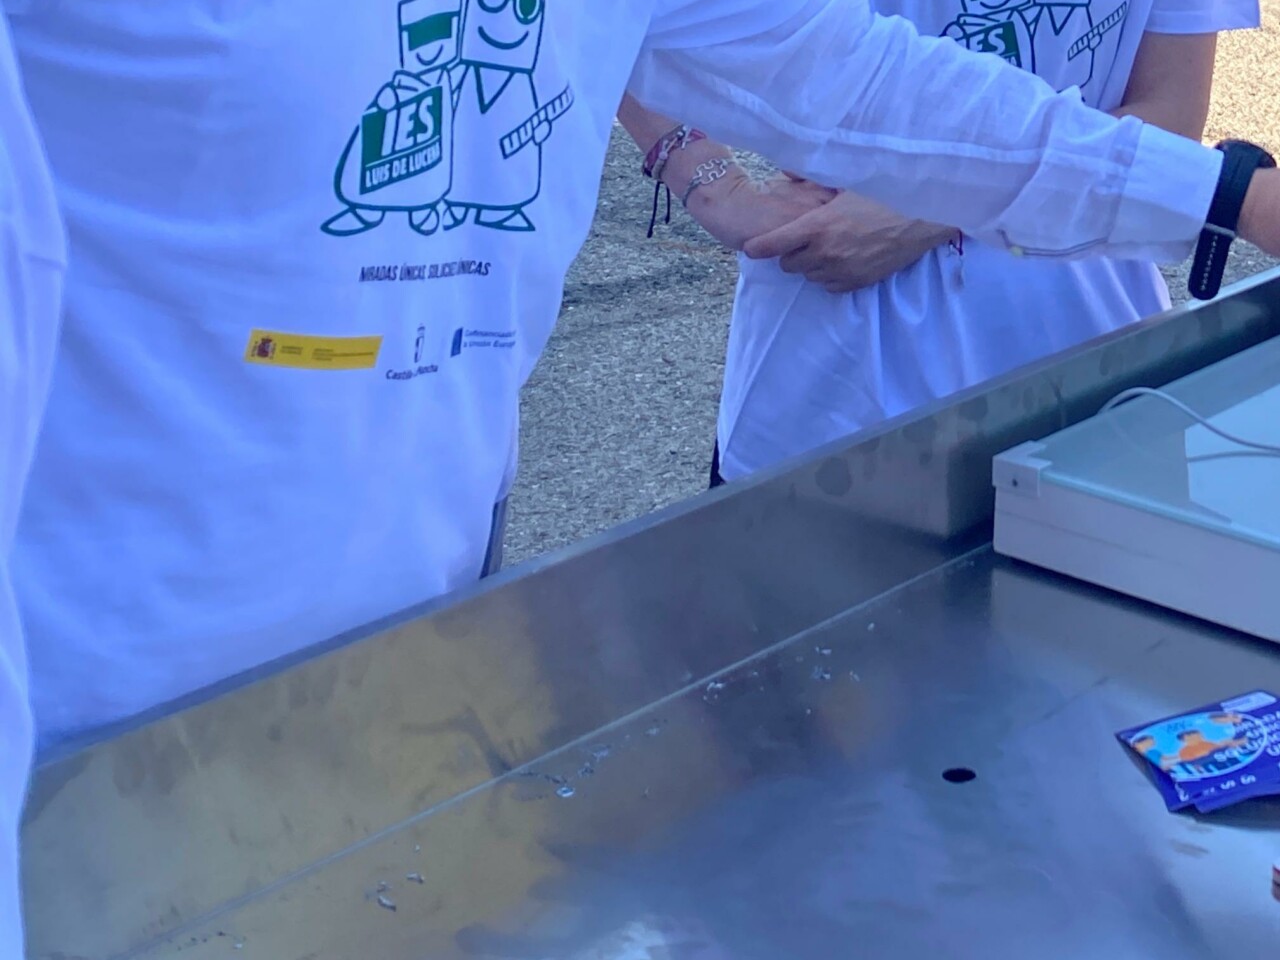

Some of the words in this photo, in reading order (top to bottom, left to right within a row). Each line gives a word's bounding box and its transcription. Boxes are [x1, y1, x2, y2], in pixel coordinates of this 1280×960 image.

[958, 27, 1006, 55] ES
[381, 96, 435, 157] IES
[365, 163, 391, 188] LUIS
[392, 157, 407, 178] DE
